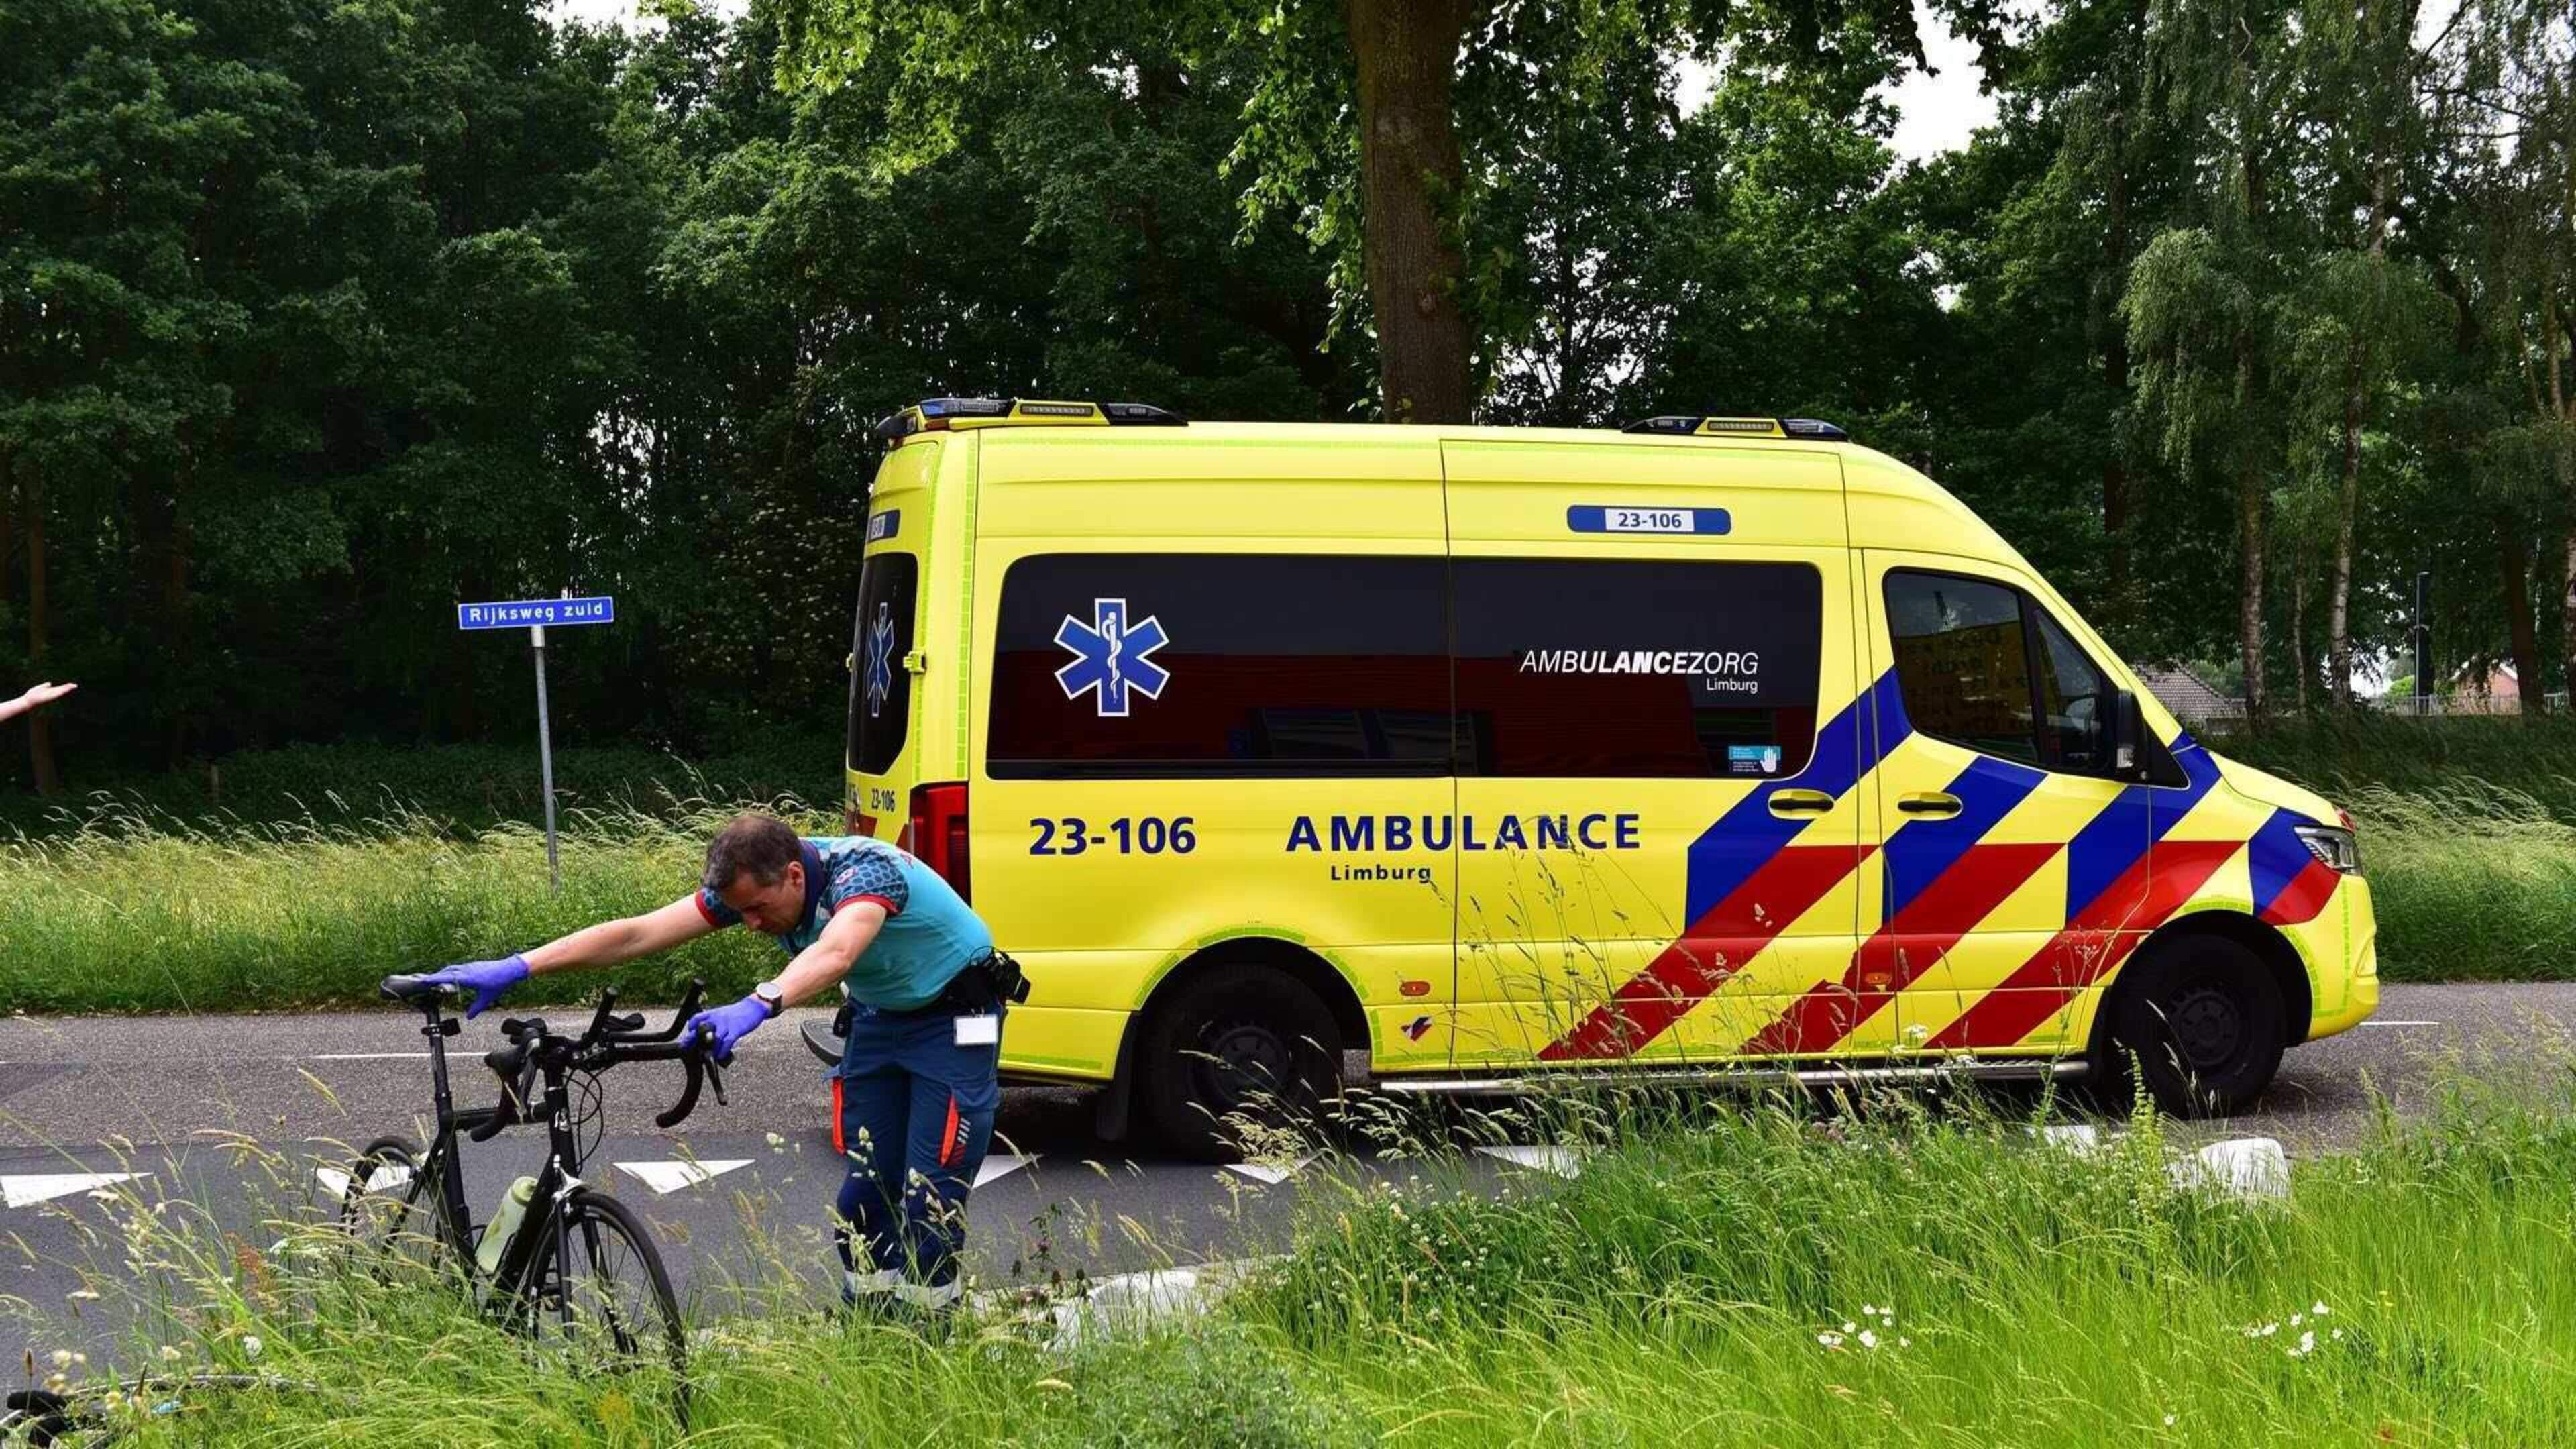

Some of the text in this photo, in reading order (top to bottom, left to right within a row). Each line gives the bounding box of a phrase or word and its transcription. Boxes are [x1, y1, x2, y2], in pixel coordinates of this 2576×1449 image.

[1618, 512, 1682, 529] 23-106
[470, 602, 603, 625] Rijksweg zuid
[1519, 649, 1759, 675] AMBULANCEZORG
[1706, 678, 1758, 694] Limburg
[1029, 816, 1196, 856] 23-106
[1286, 813, 1641, 852] AMBULANCE
[1330, 864, 1432, 885] Limburg
